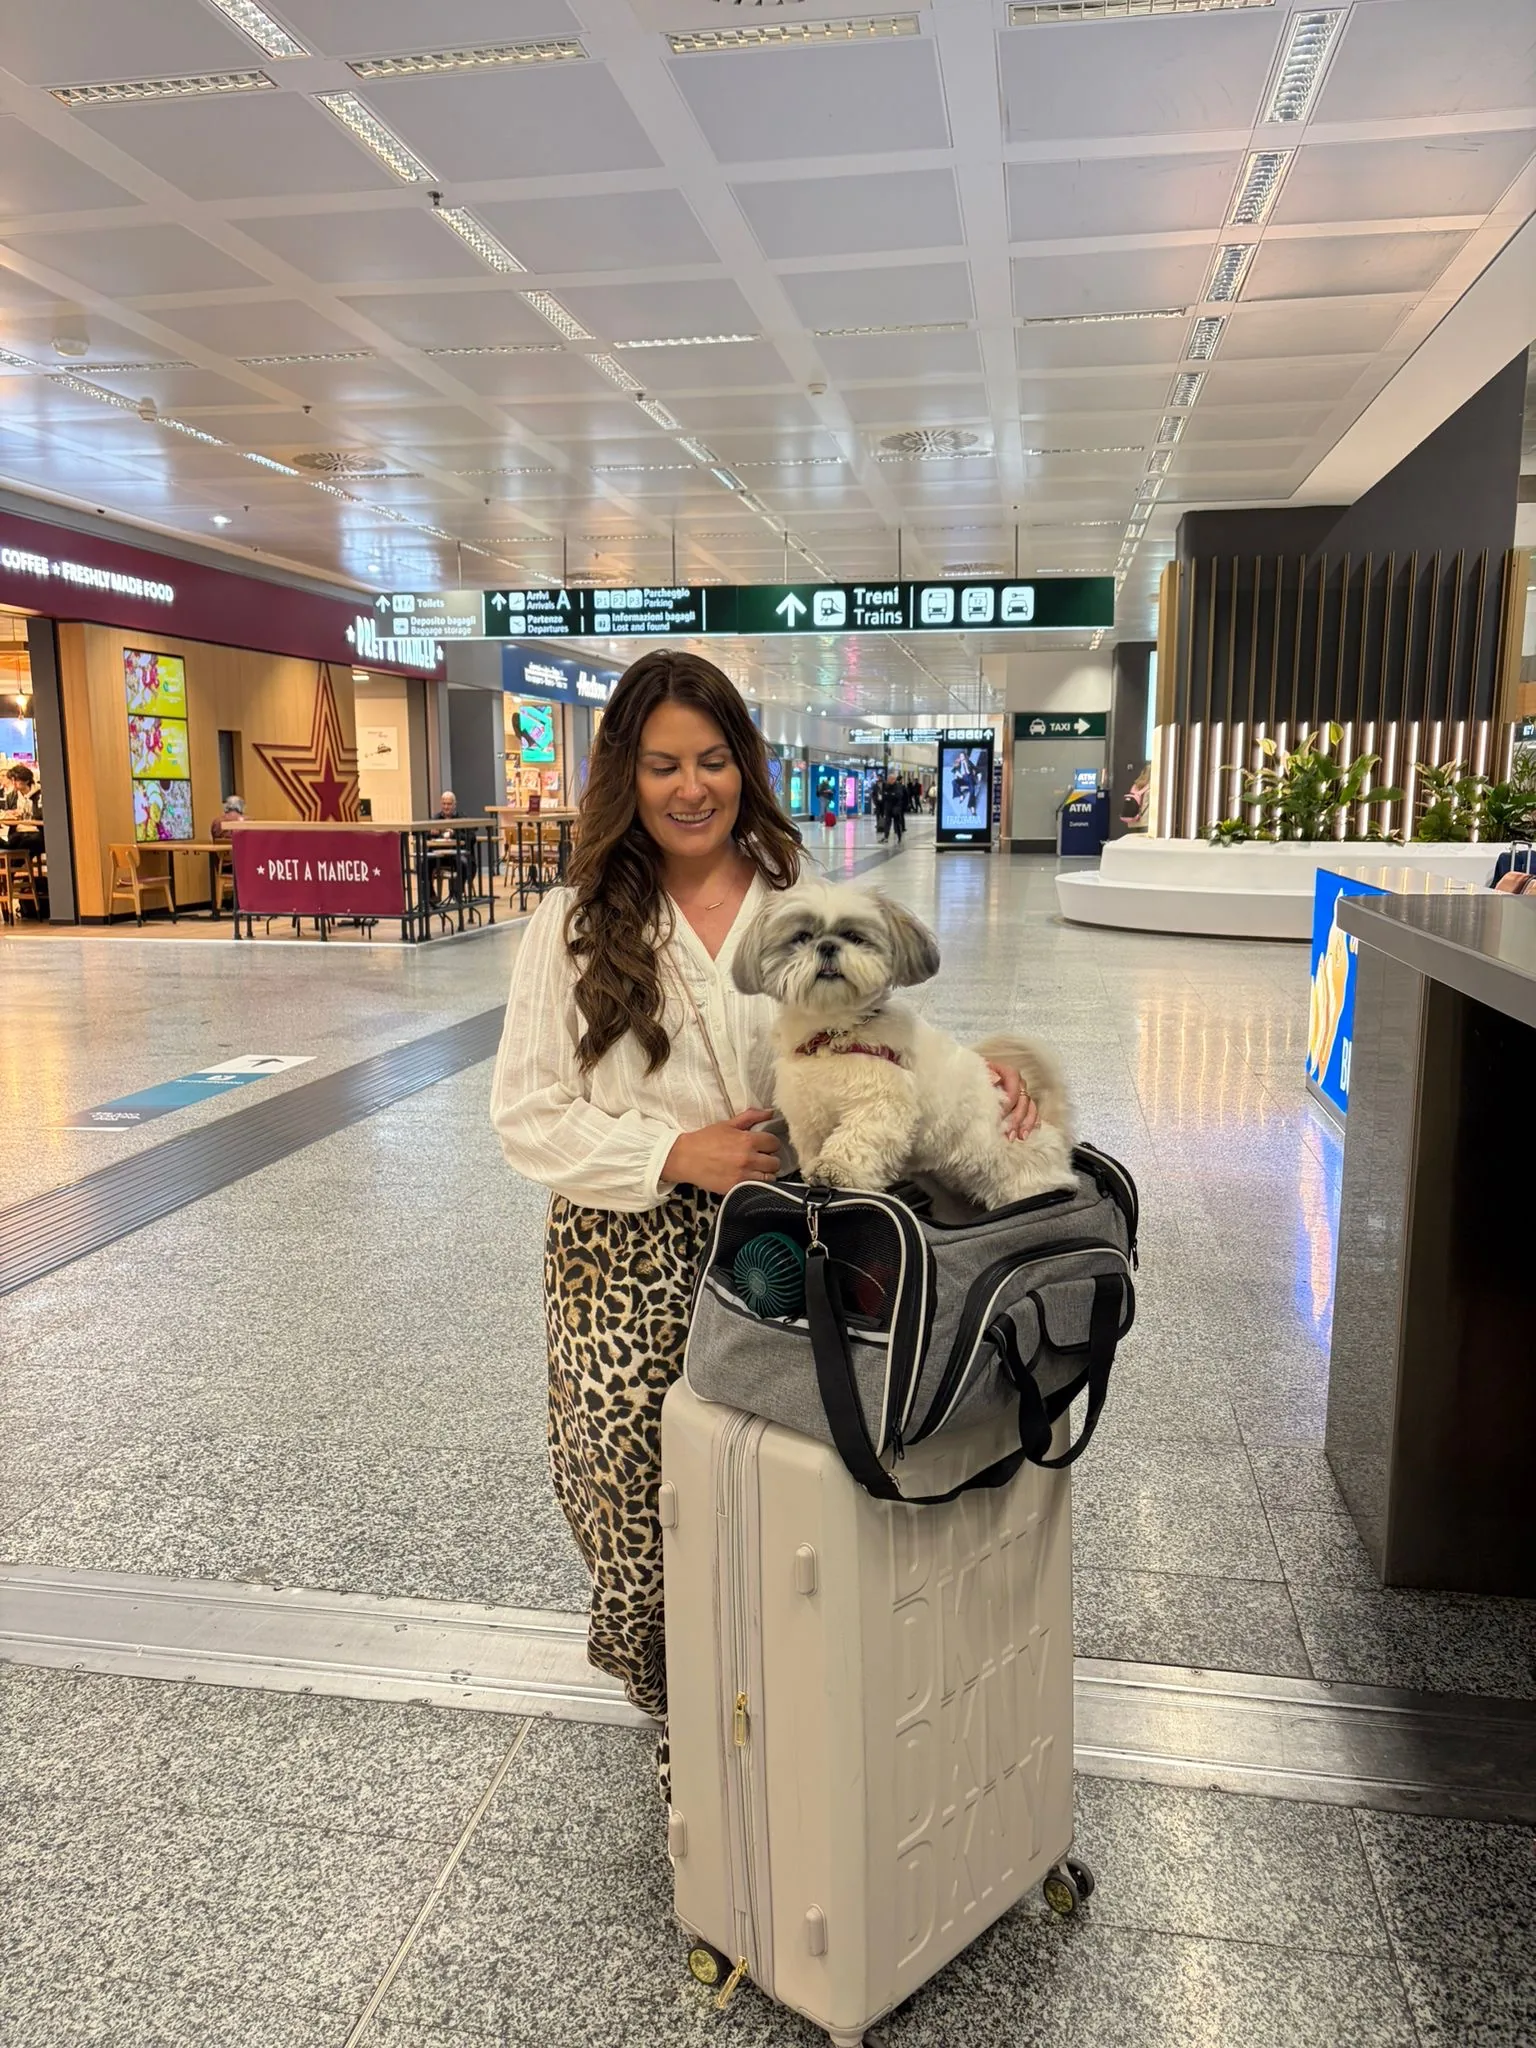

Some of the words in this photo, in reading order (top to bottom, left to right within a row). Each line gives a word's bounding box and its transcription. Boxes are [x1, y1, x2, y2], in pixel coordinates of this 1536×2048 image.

[1, 548, 49, 575] COFFEE
[61, 561, 111, 589] FRESHLY
[111, 573, 142, 596] MADE
[143, 581, 175, 602] FOOD
[526, 590, 549, 600] Arrivi
[643, 587, 690, 599] Parcheggio
[853, 586, 899, 605] Treni
[417, 598, 445, 608] Toilets
[556, 589, 571, 610] A
[644, 598, 674, 609] Parking
[526, 601, 555, 610] Arrivals
[410, 616, 446, 627] Deposito
[447, 615, 476, 627] bagagli
[527, 614, 563, 624] Partenze
[612, 612, 664, 622] Informazioni
[664, 610, 696, 622] bagagli
[853, 607, 903, 626] Trains
[410, 627, 443, 636] Baggage
[444, 627, 472, 636] storage
[527, 624, 569, 635] Departures
[612, 623, 629, 632] Lost
[630, 622, 645, 632] and
[646, 622, 670, 631] found
[1049, 723, 1071, 732] TAXI
[1077, 773, 1097, 782] ATM
[1069, 803, 1092, 813] ATM
[268, 859, 299, 881] PRET
[304, 860, 313, 881] A
[317, 860, 369, 882] MANGER
